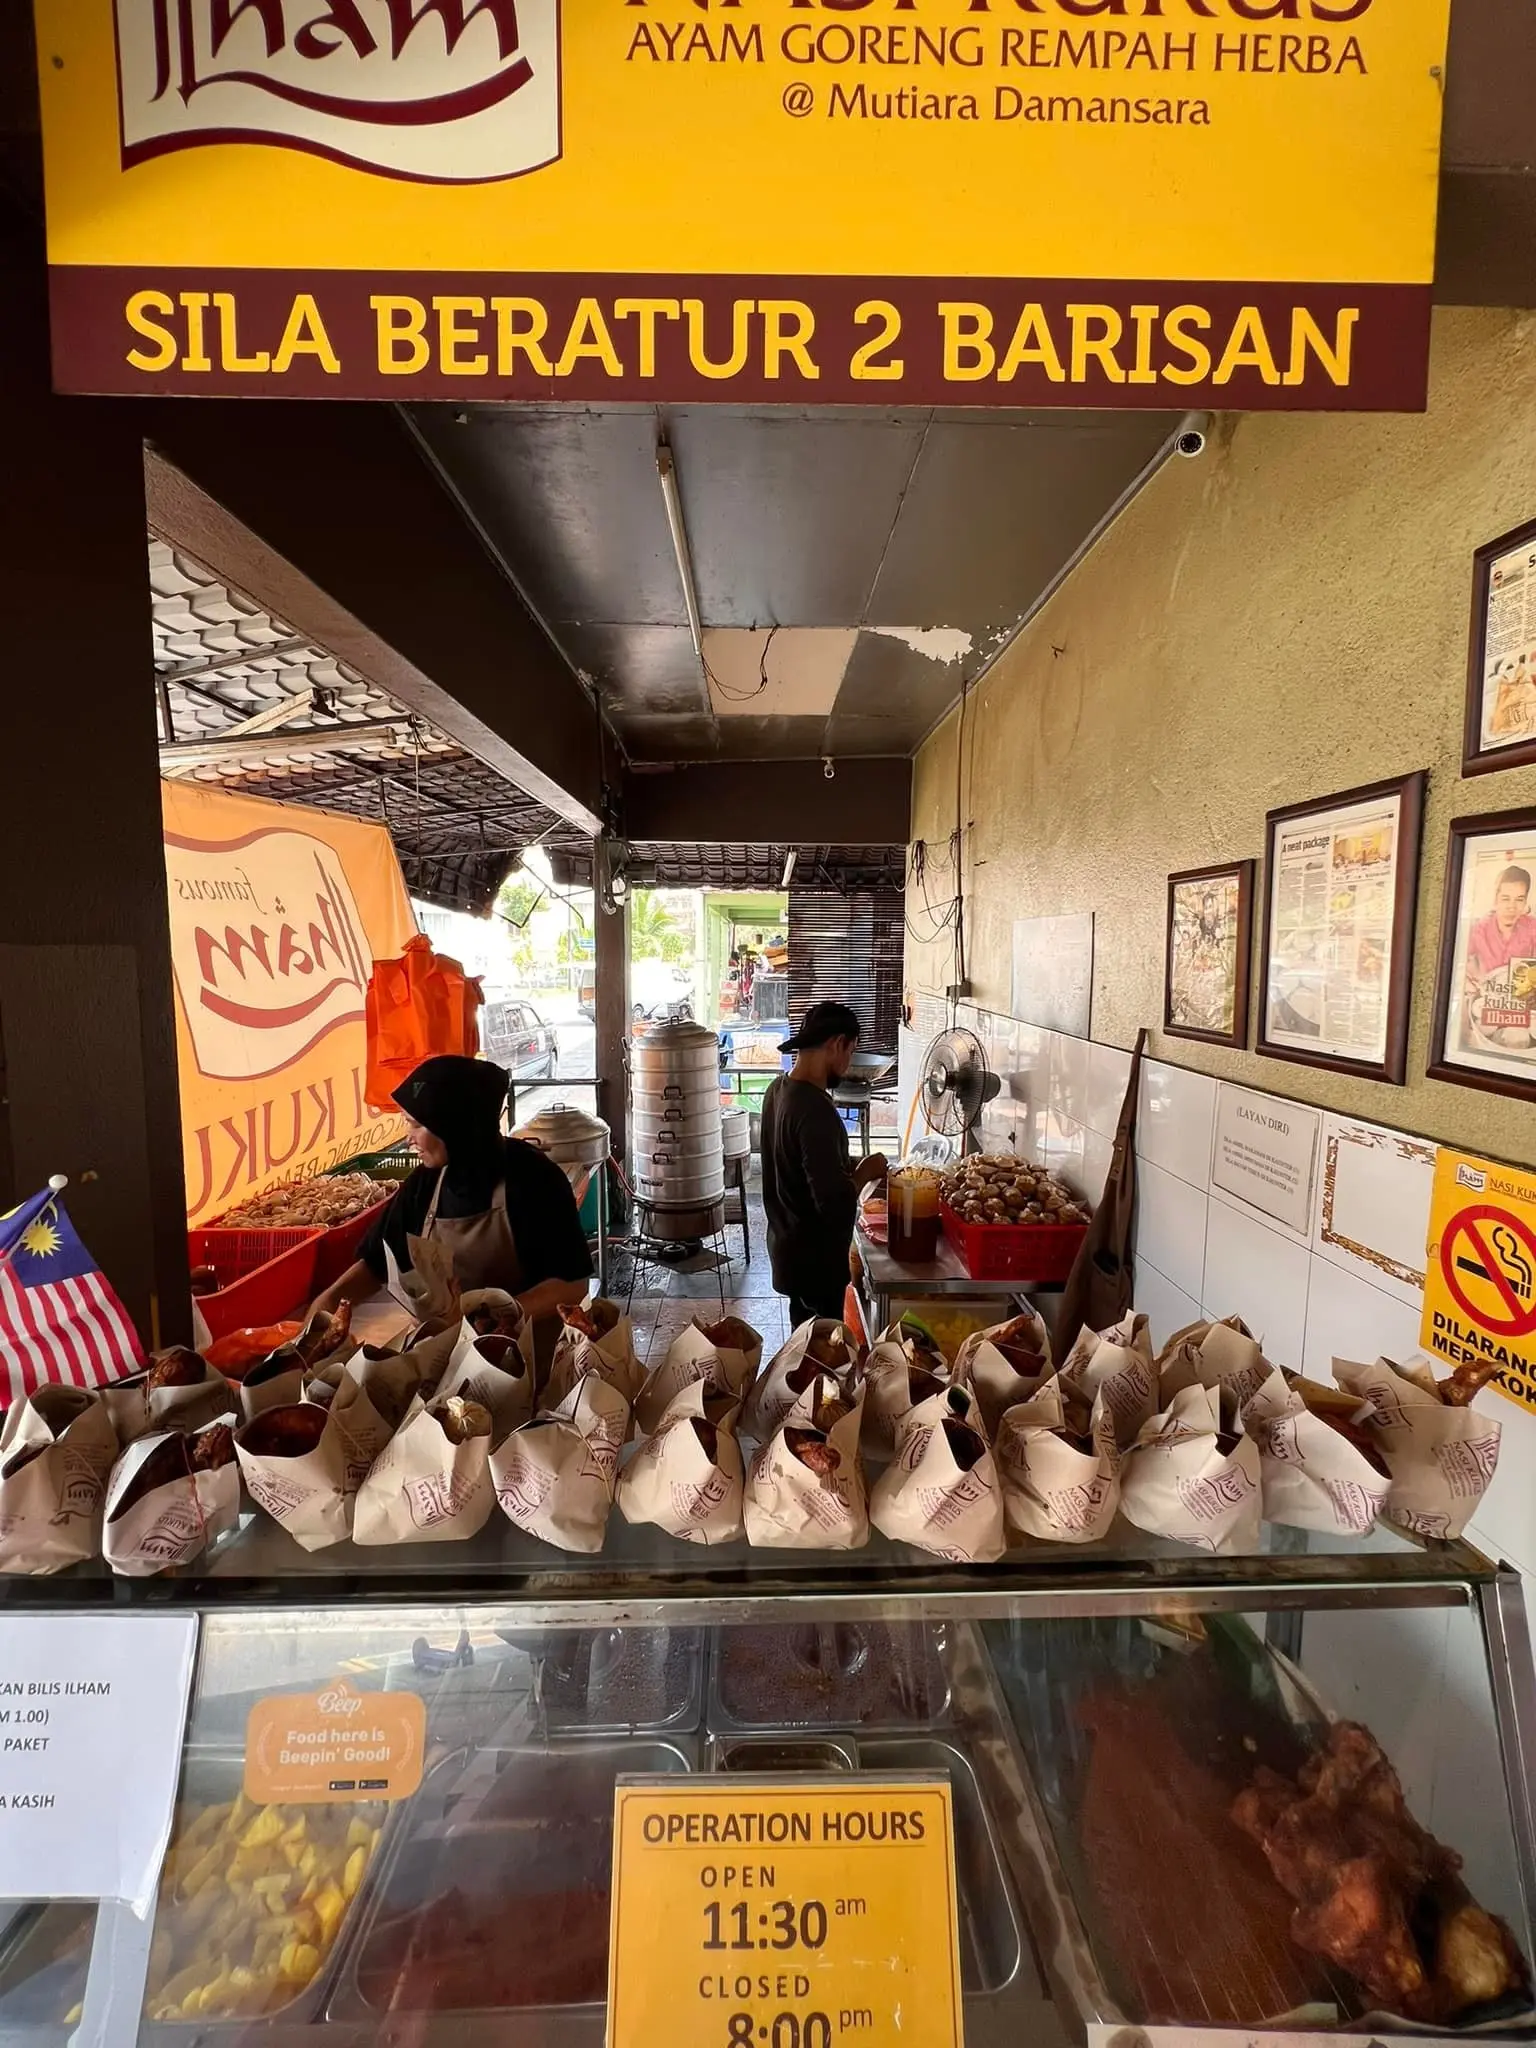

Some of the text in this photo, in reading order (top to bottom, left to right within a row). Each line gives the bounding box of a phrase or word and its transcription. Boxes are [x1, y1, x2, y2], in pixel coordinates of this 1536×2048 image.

[625, 22, 1369, 75] AYAM GORENG REMPAH HERBA
[782, 81, 1211, 126] @ Mutiara Damansara
[125, 290, 1361, 387] SILA BERATUR 2 BARISAN
[1485, 979, 1514, 994] Nasi
[1484, 994, 1526, 1011] kukus
[1486, 1010, 1527, 1025] Ilham
[1490, 1178, 1515, 1194] NASI
[28, 1682, 62, 1696] BILIS
[65, 1682, 111, 1696] ILHAM
[14, 1709, 49, 1726] 1.00)
[4, 1737, 50, 1752] PAKET
[287, 1730, 327, 1745] Food
[331, 1728, 369, 1743] here
[280, 1746, 391, 1766] Beepin' Good!
[11, 1794, 55, 1809] KASIH
[643, 1811, 926, 1844] OPERATION HOURS
[700, 1865, 776, 1889] OPEN
[702, 1897, 867, 1951] 11:30 am
[699, 1975, 811, 2000] CLOSED
[727, 2007, 873, 2048] 8:00 pm
